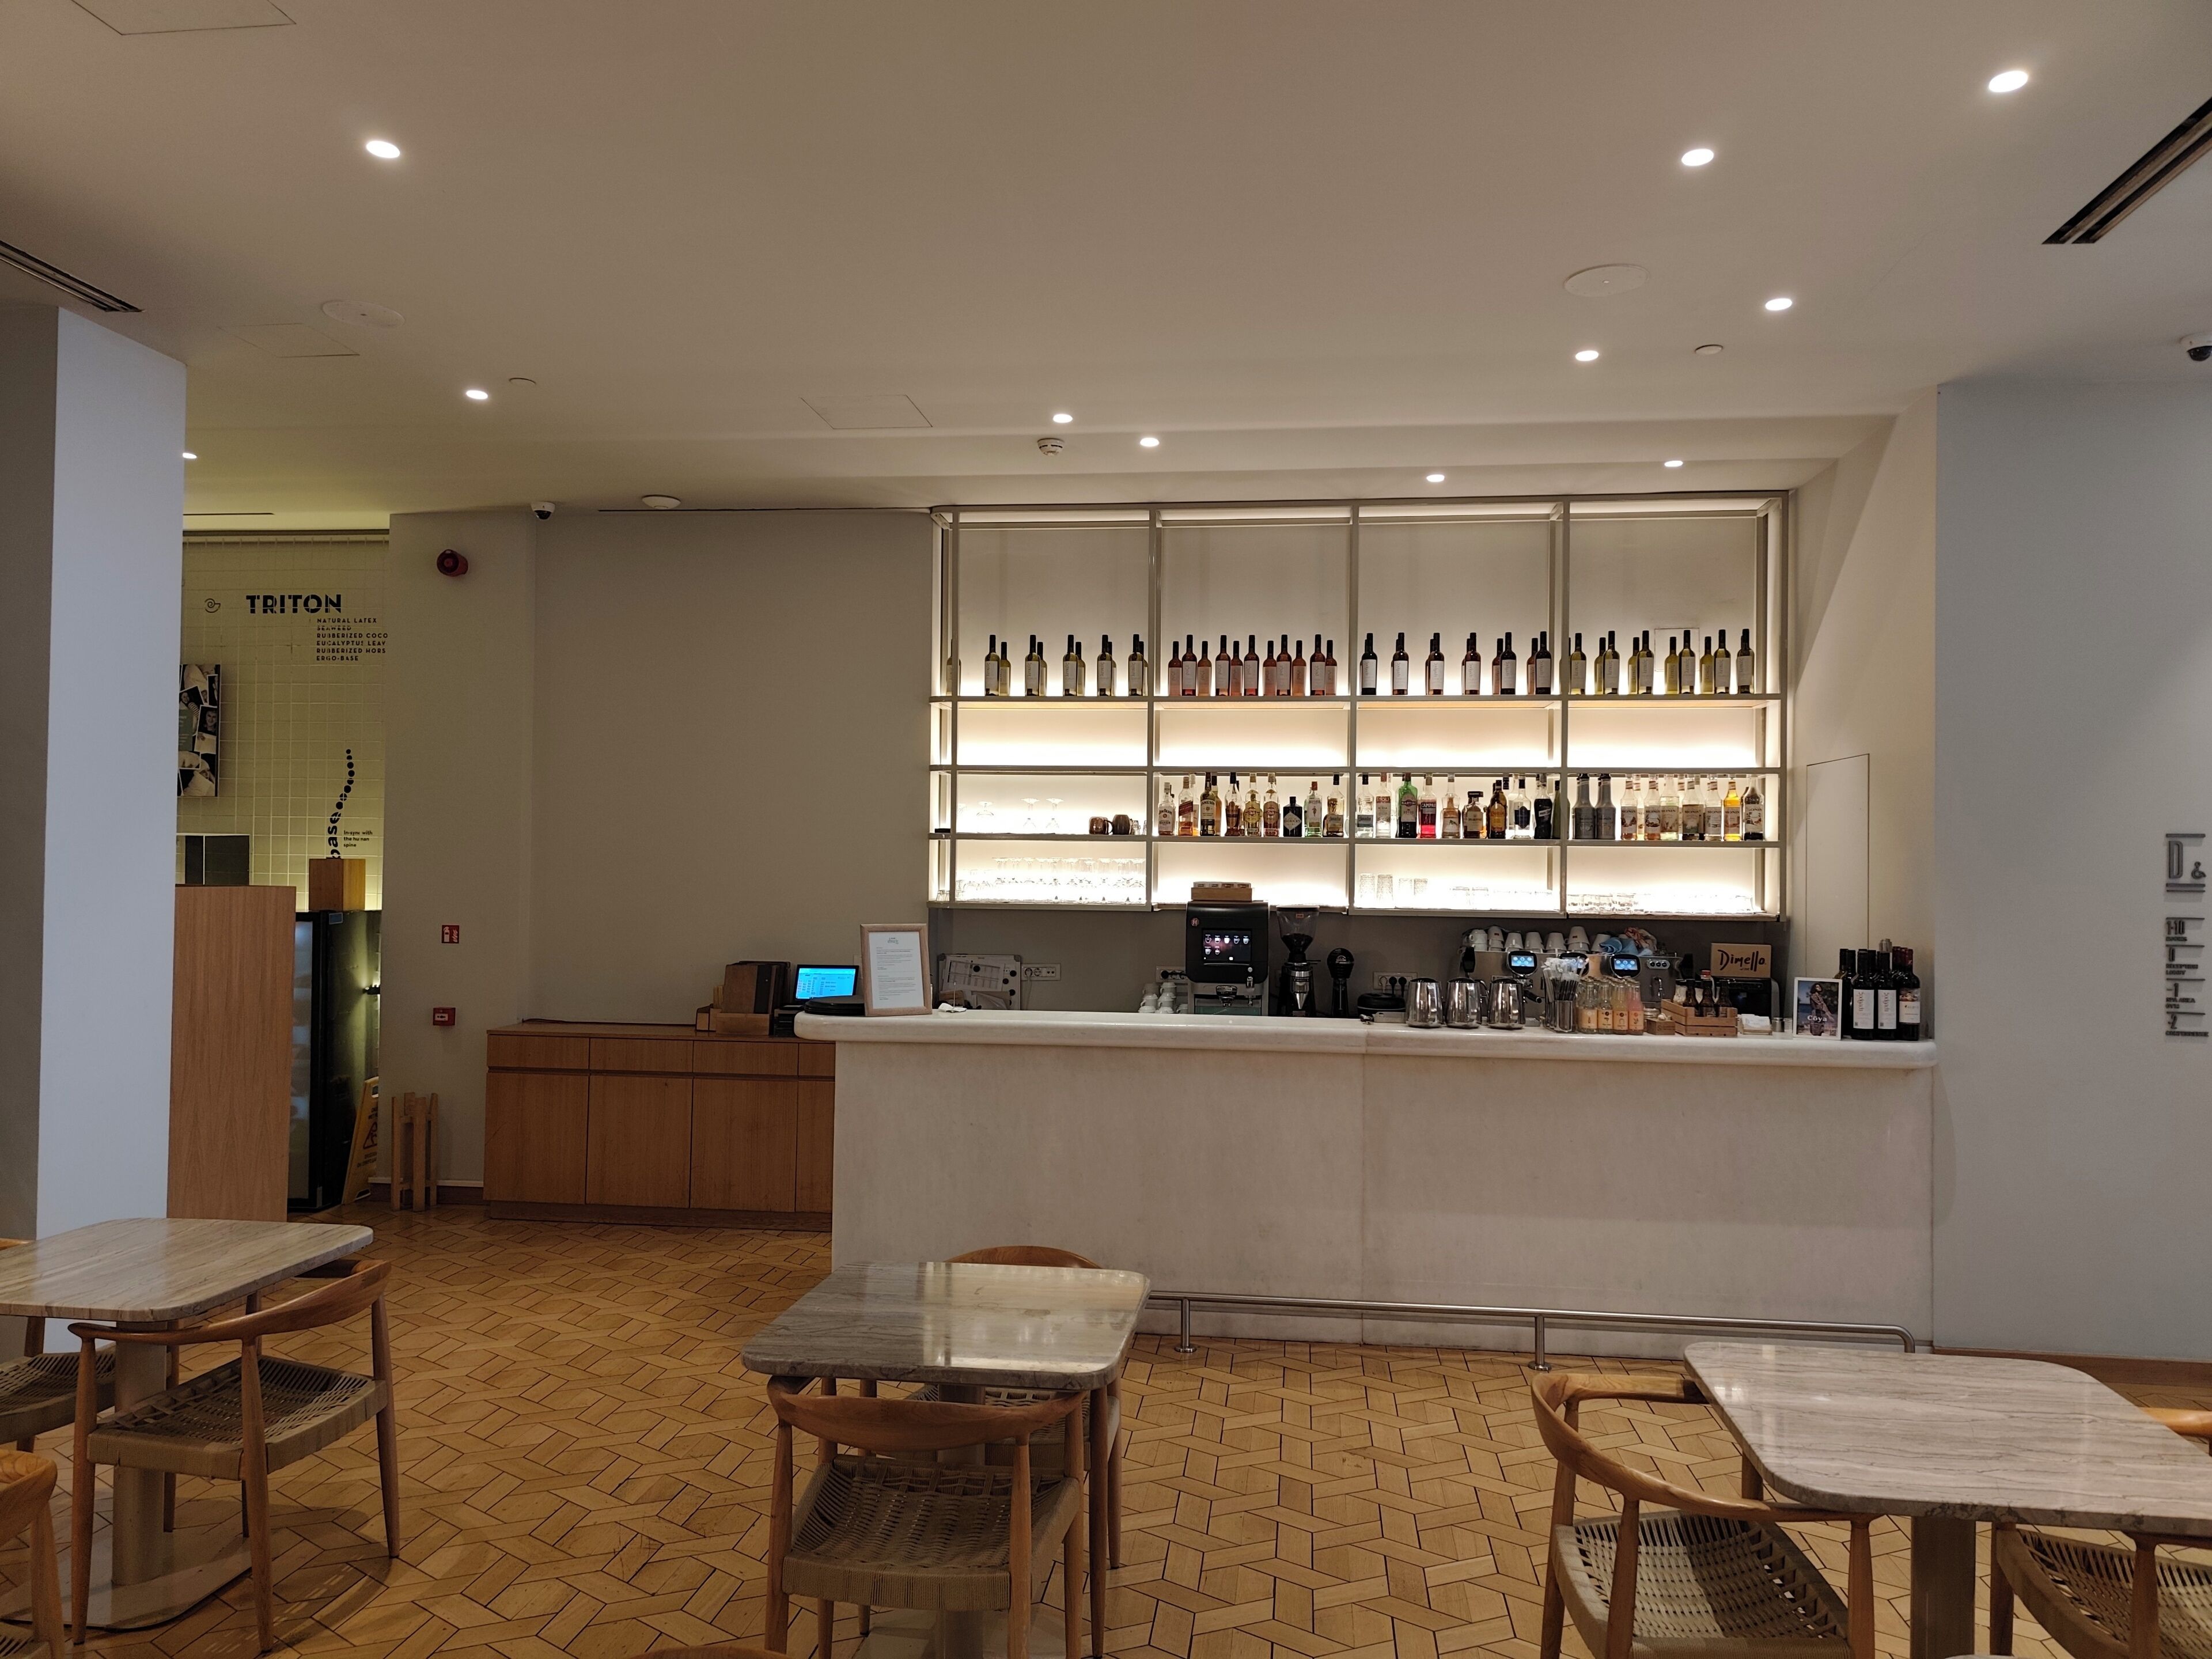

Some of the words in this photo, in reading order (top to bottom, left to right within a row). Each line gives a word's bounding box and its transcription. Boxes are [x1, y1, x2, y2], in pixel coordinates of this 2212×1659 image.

[246, 594, 341, 613] TRITON
[2169, 840, 2183, 878] D
[2166, 920, 2185, 935] 1-10
[1717, 949, 1766, 972] Dimello
[2166, 983, 2179, 997] -1
[2168, 1014, 2177, 1029] -2
